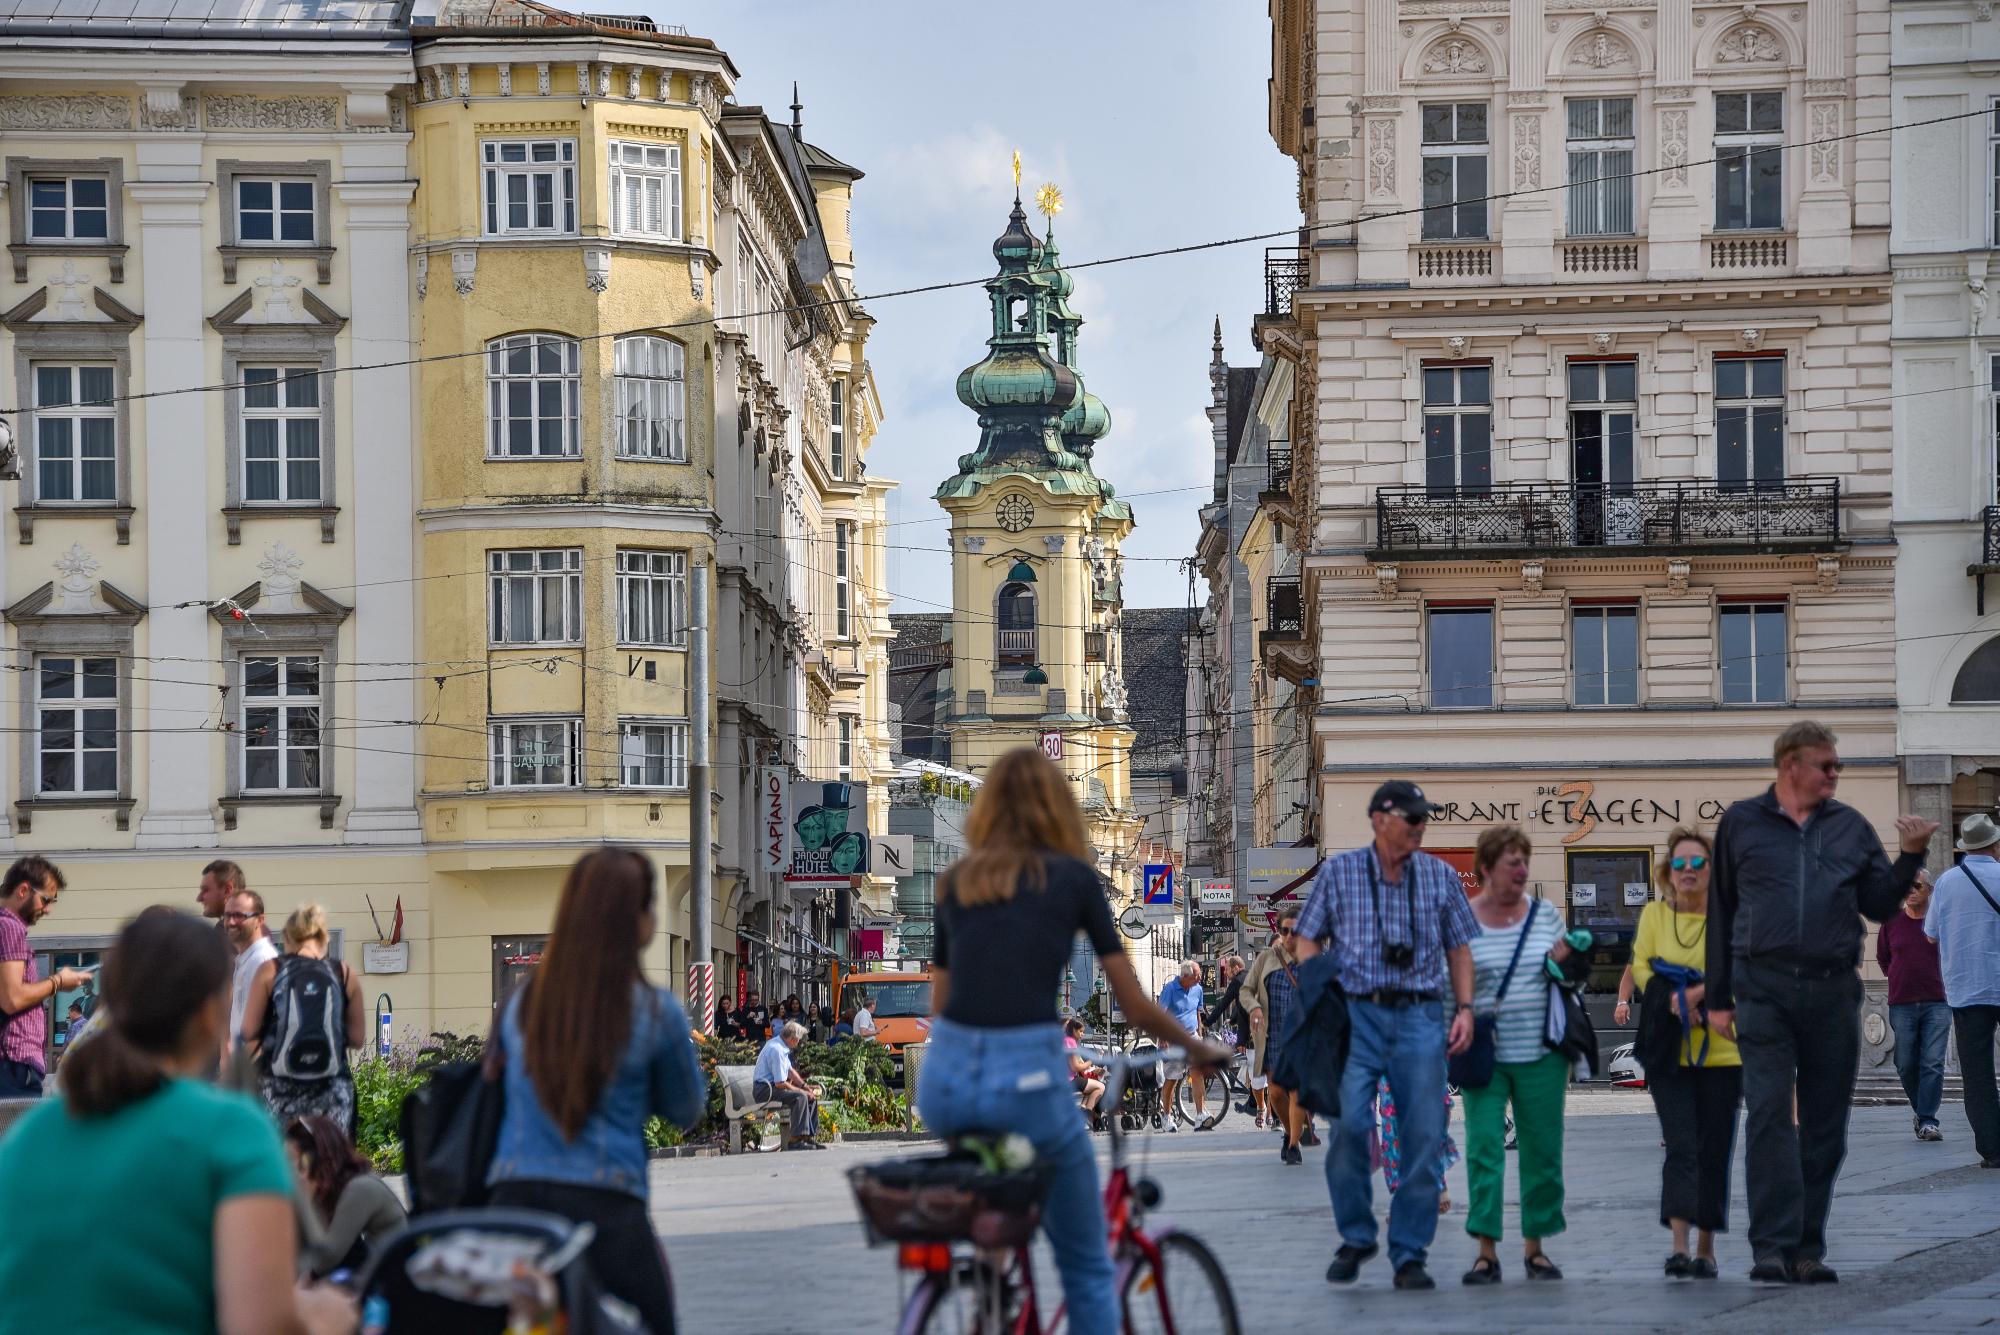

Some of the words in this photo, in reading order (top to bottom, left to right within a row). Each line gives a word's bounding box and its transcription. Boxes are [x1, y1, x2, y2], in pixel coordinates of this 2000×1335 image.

[1045, 737, 1060, 758] 30
[767, 776, 783, 866] VAPIANO
[1427, 802, 1520, 822] URANT
[1538, 786, 1558, 796] DIE
[1558, 780, 1597, 844] 3
[1541, 799, 1680, 826] ETAGEN
[795, 851, 829, 861] JANOUT
[1203, 892, 1231, 900] NOTAR
[863, 950, 880, 960] IPA
